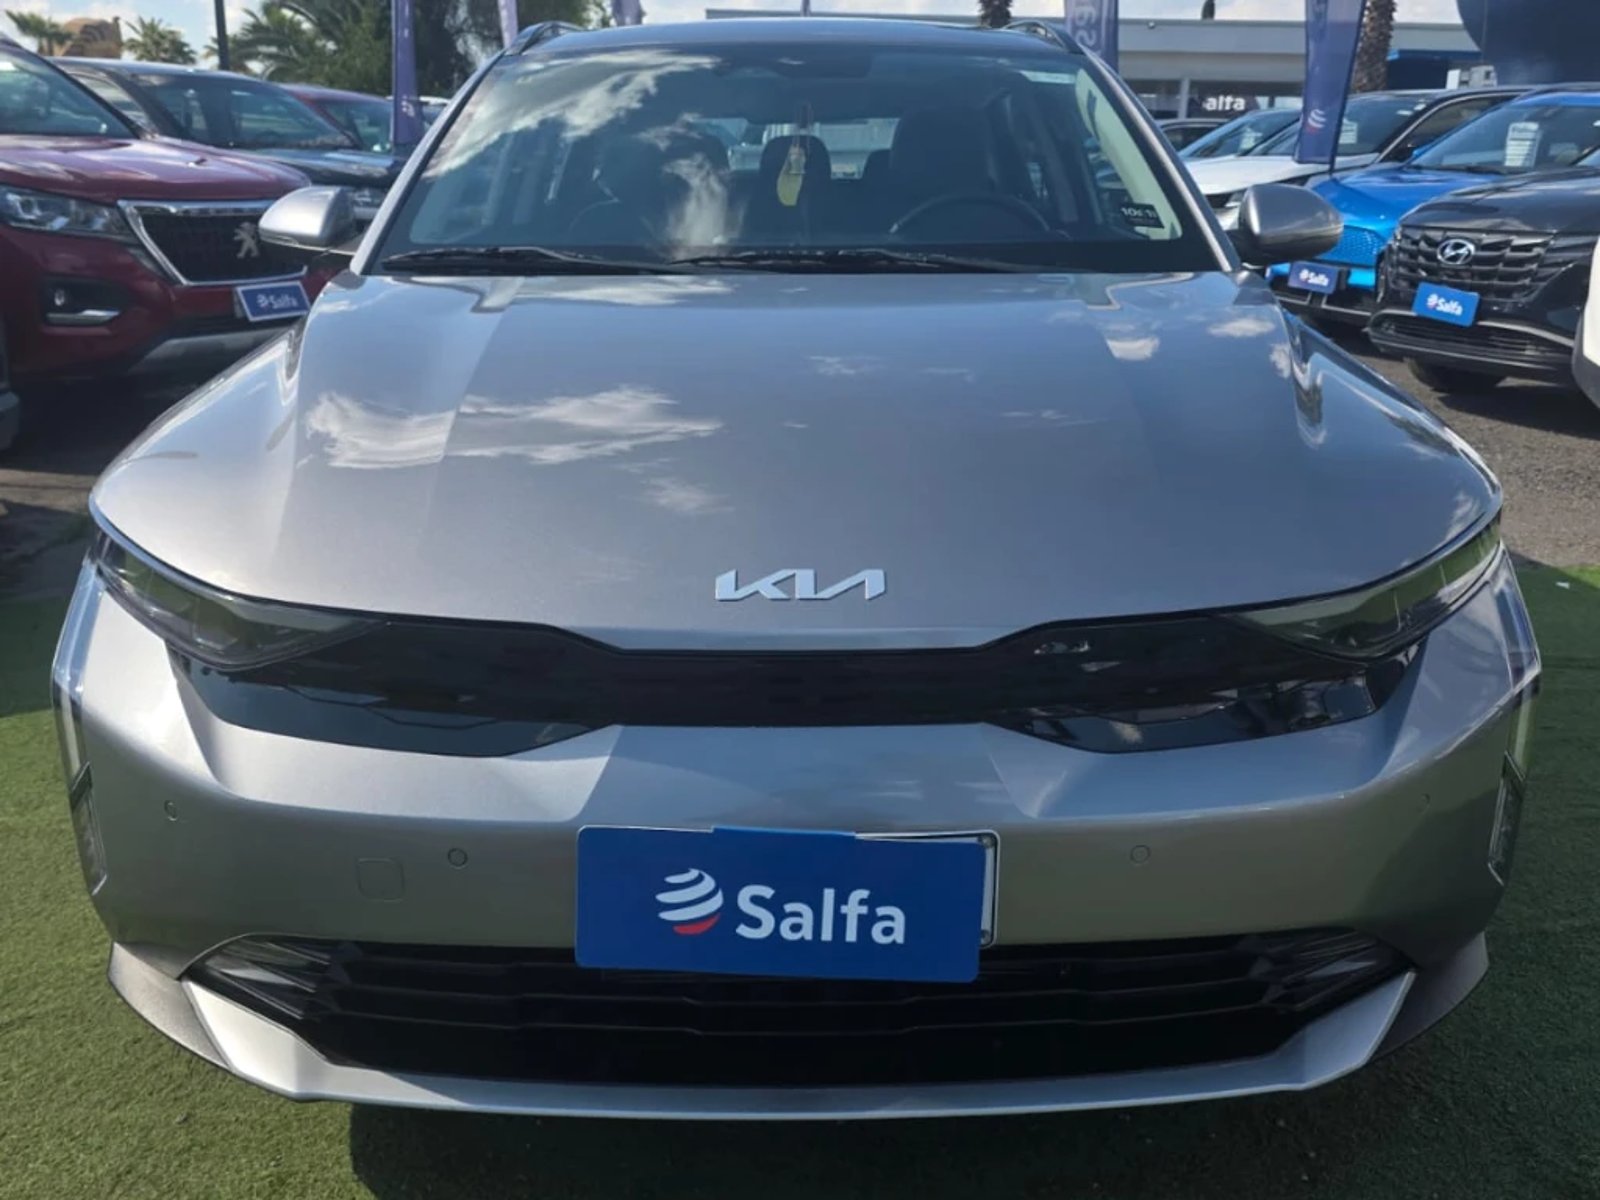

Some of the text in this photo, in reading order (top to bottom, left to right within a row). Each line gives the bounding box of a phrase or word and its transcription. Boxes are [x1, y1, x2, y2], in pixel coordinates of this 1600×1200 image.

[1202, 94, 1246, 111] alfa
[1436, 297, 1463, 316] Salfa
[715, 568, 886, 601] KIA
[735, 884, 906, 945] Salfa
